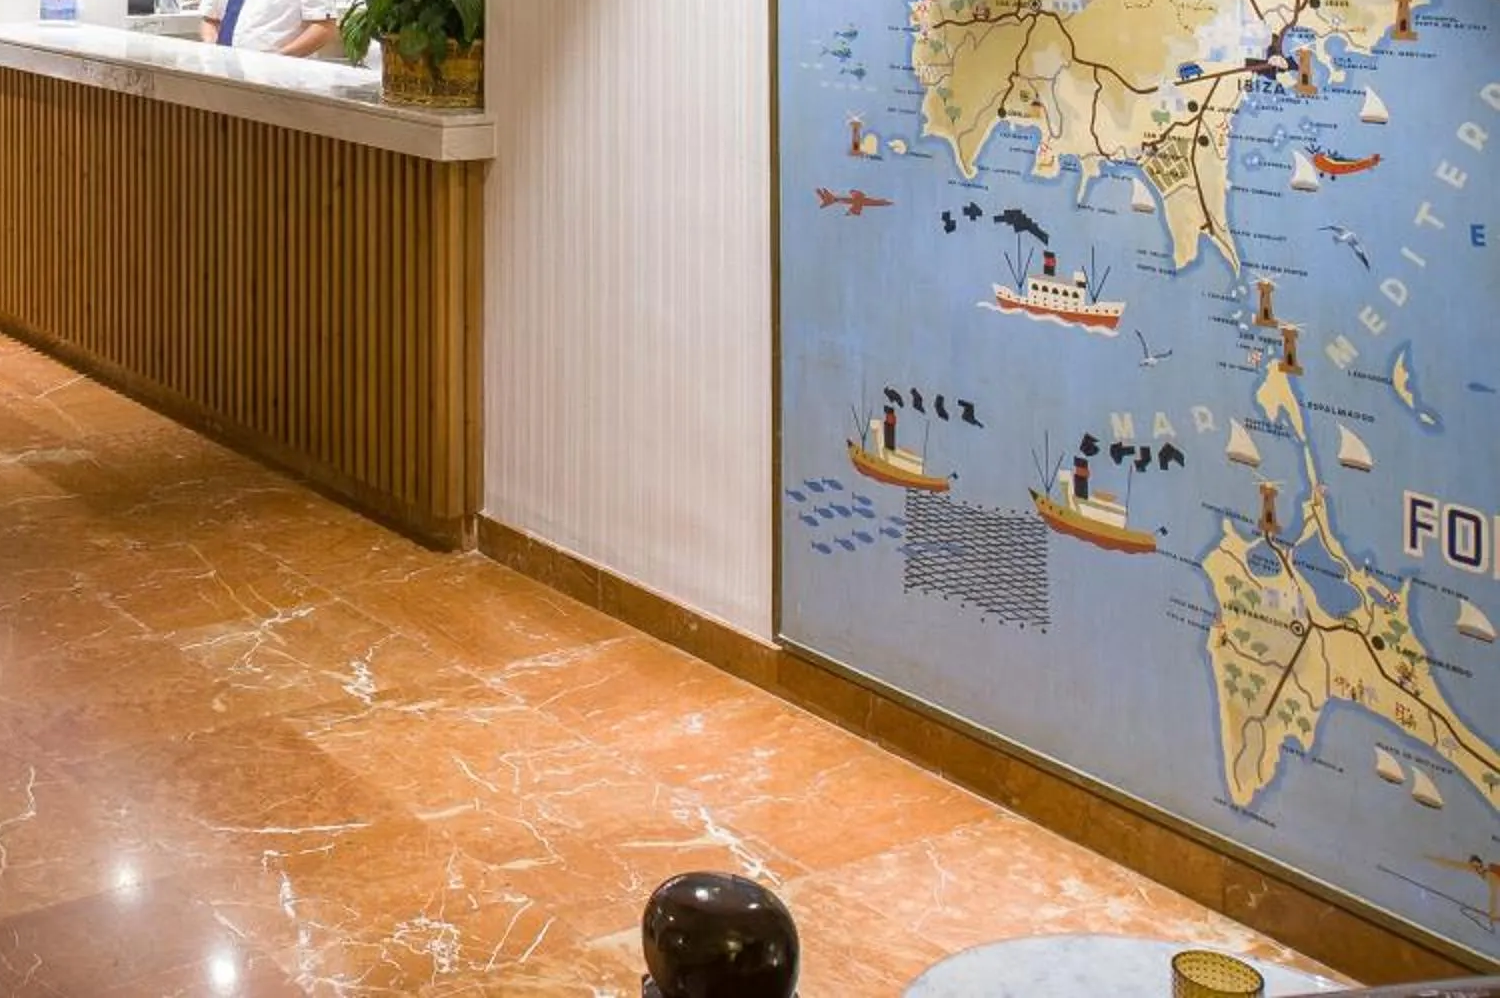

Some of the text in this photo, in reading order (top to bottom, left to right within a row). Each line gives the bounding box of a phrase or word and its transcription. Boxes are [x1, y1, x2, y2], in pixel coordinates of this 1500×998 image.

[1237, 79, 1286, 95] IBIZA
[1109, 405, 1217, 440] MAR
[1404, 490, 1500, 580] FO
